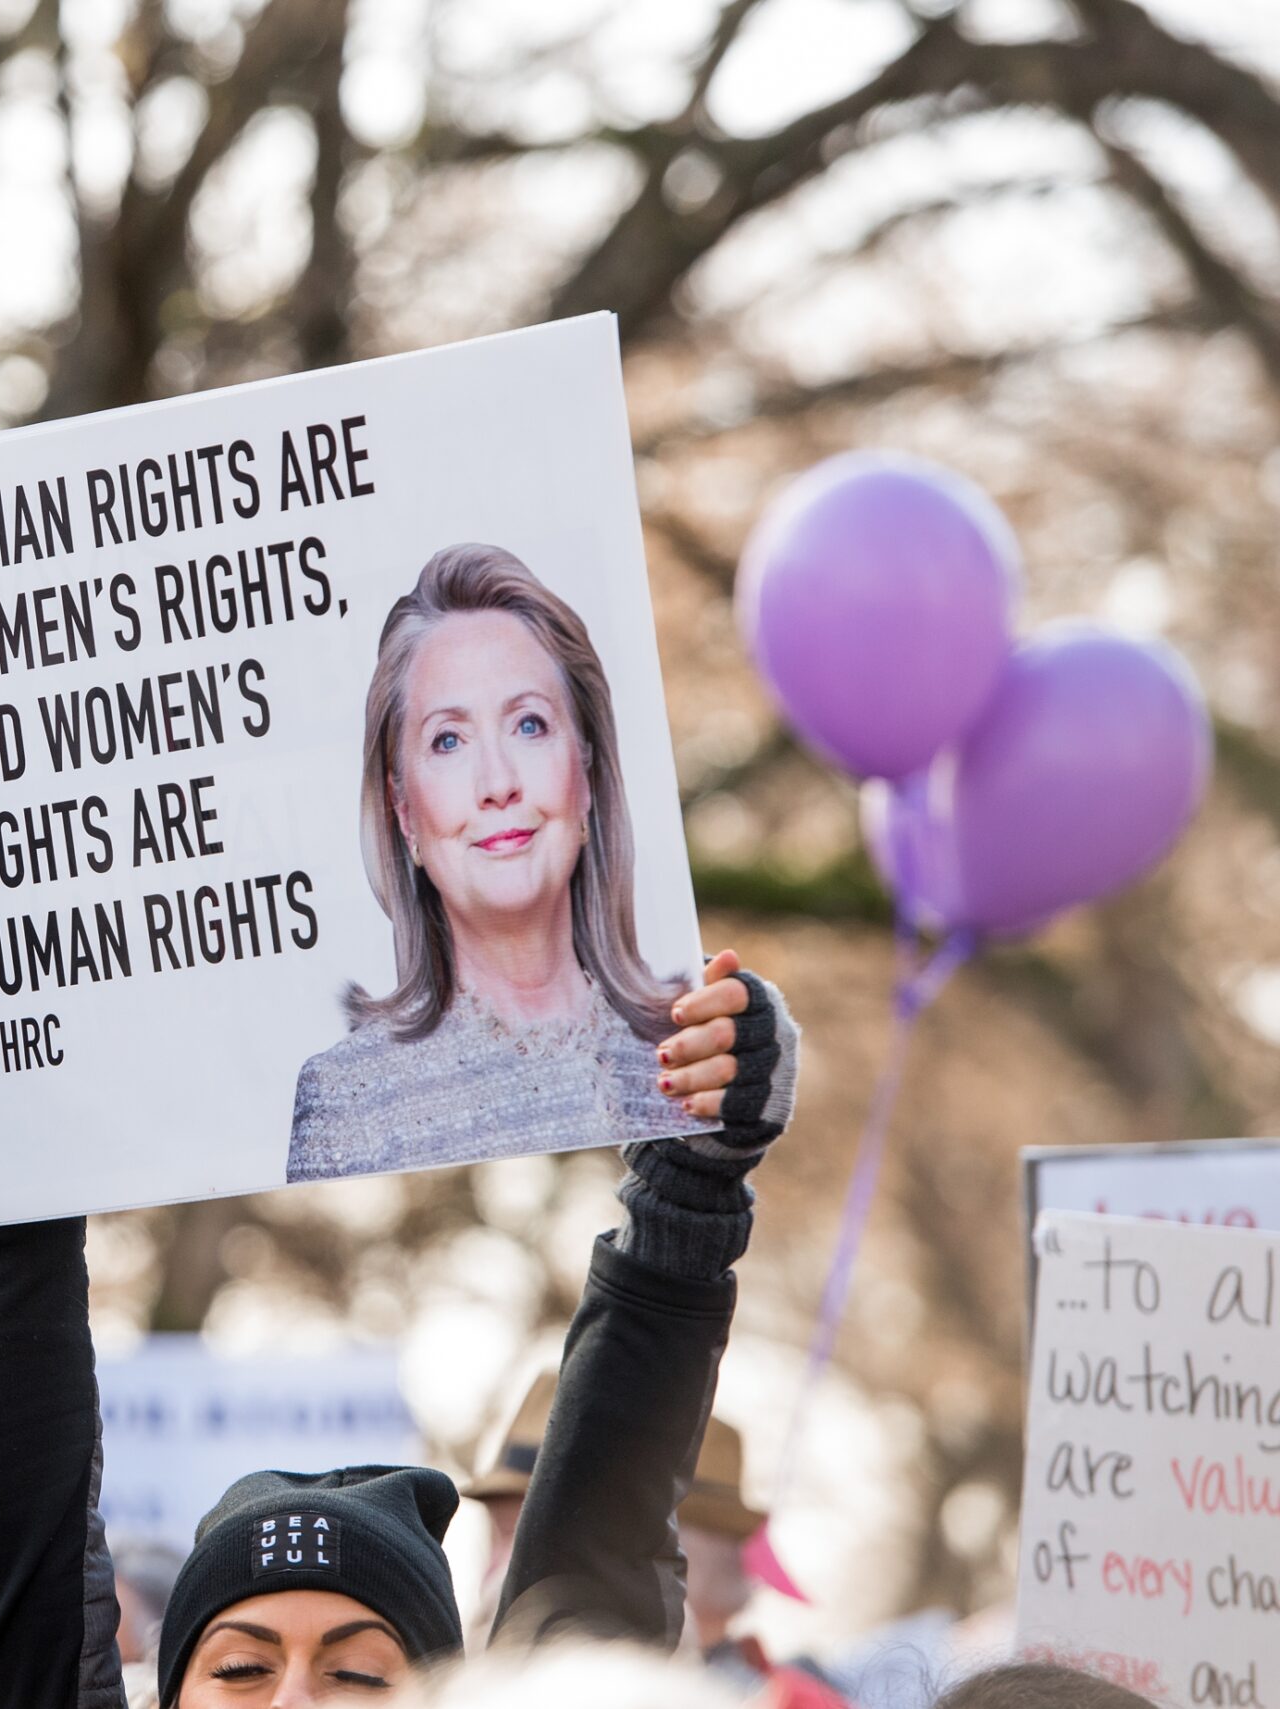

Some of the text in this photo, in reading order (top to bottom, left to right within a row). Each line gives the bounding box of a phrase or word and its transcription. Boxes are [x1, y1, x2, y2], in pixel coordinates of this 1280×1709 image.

[87, 440, 260, 548] RIGHTS
[281, 416, 375, 512] ARE
[155, 537, 347, 643] RIGHTS,
[38, 659, 270, 772] WOMEN’S
[133, 776, 223, 867] ARE
[144, 871, 318, 973] RIGHTS
[0, 1014, 64, 1073] HRC
[1045, 1441, 1280, 1517] are valu
[1033, 1520, 1091, 1590] of
[1101, 1551, 1194, 1618] every
[1190, 1660, 1267, 1708] and
